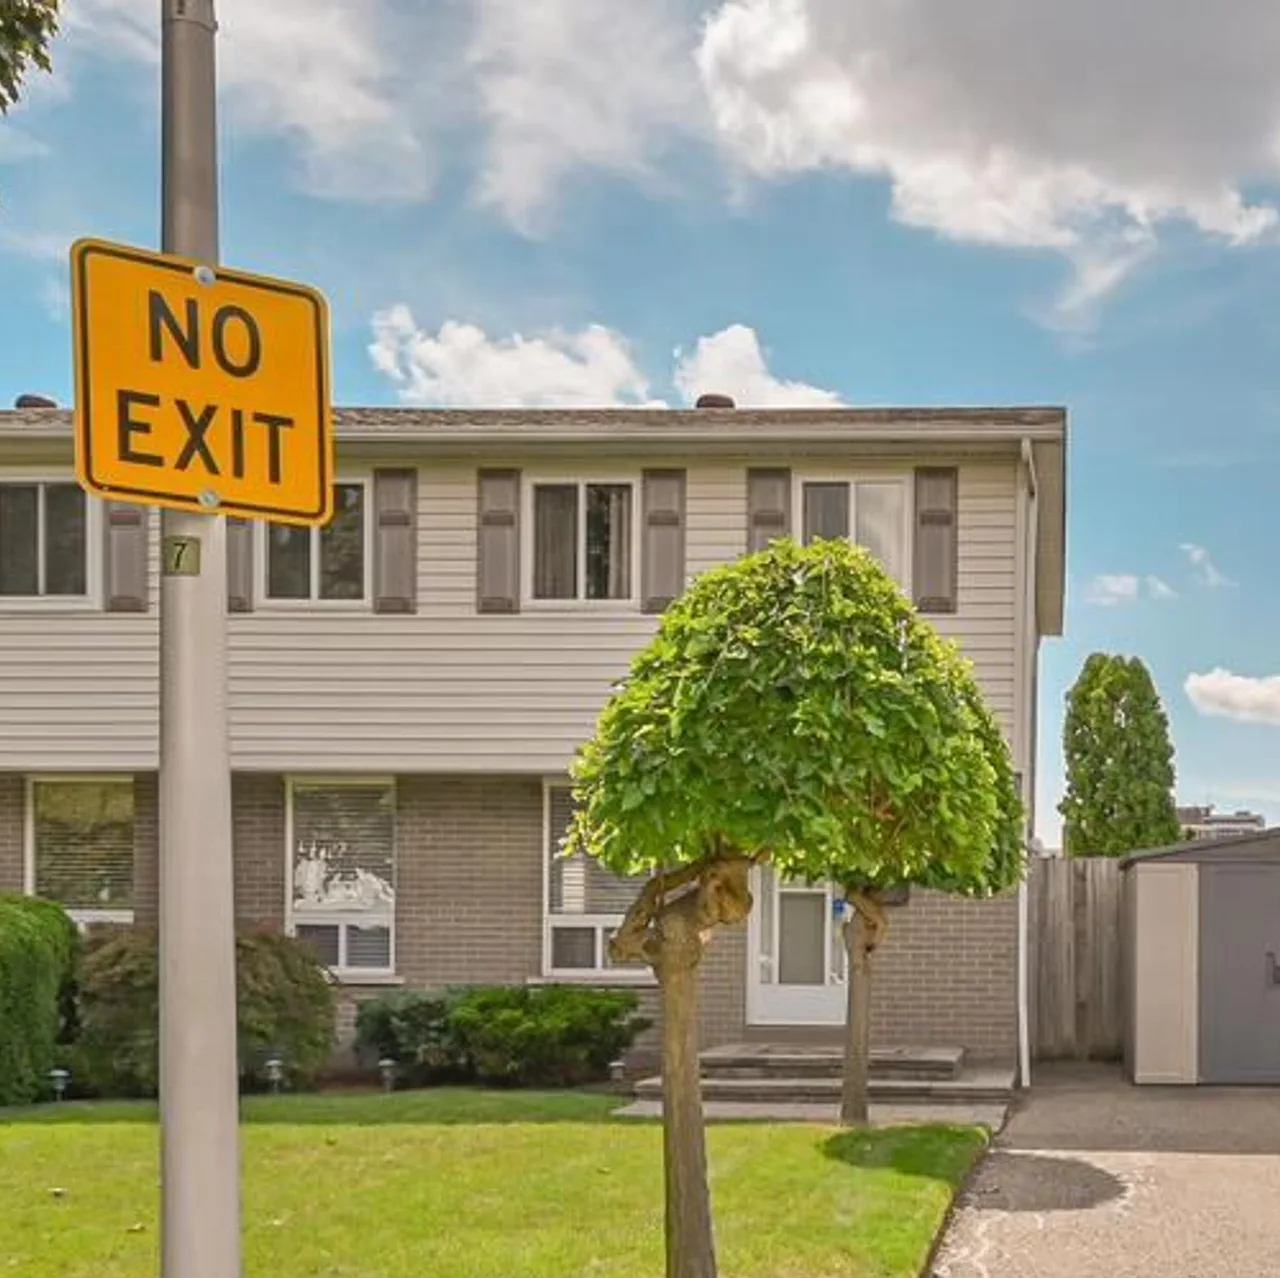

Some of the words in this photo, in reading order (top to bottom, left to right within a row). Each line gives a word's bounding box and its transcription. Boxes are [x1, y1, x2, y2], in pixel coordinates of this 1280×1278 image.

[148, 289, 261, 378] NO
[117, 389, 294, 484] EXIT
[173, 542, 188, 570] 7
